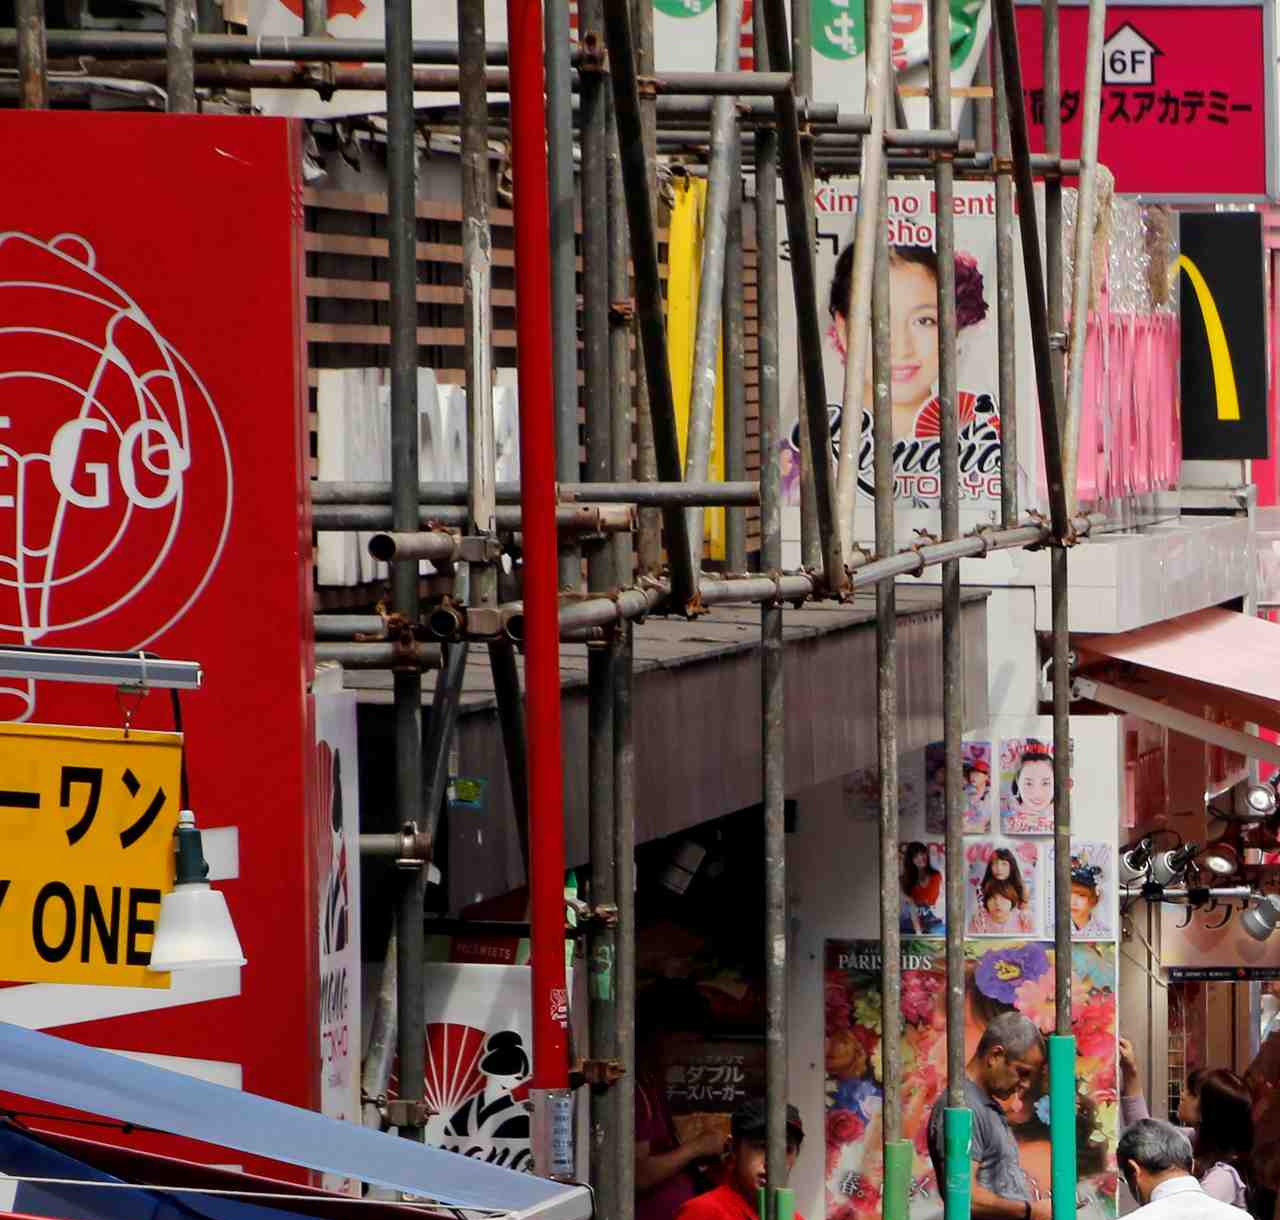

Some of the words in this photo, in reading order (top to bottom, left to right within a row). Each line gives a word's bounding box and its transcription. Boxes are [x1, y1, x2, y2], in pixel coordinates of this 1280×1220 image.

[1110, 49, 1146, 75] 6F
[815, 189, 918, 213] Kimno
[0, 417, 182, 510] GO
[895, 475, 1002, 499] TOYO
[32, 880, 166, 967] ONE
[901, 954, 932, 970] ID'S
